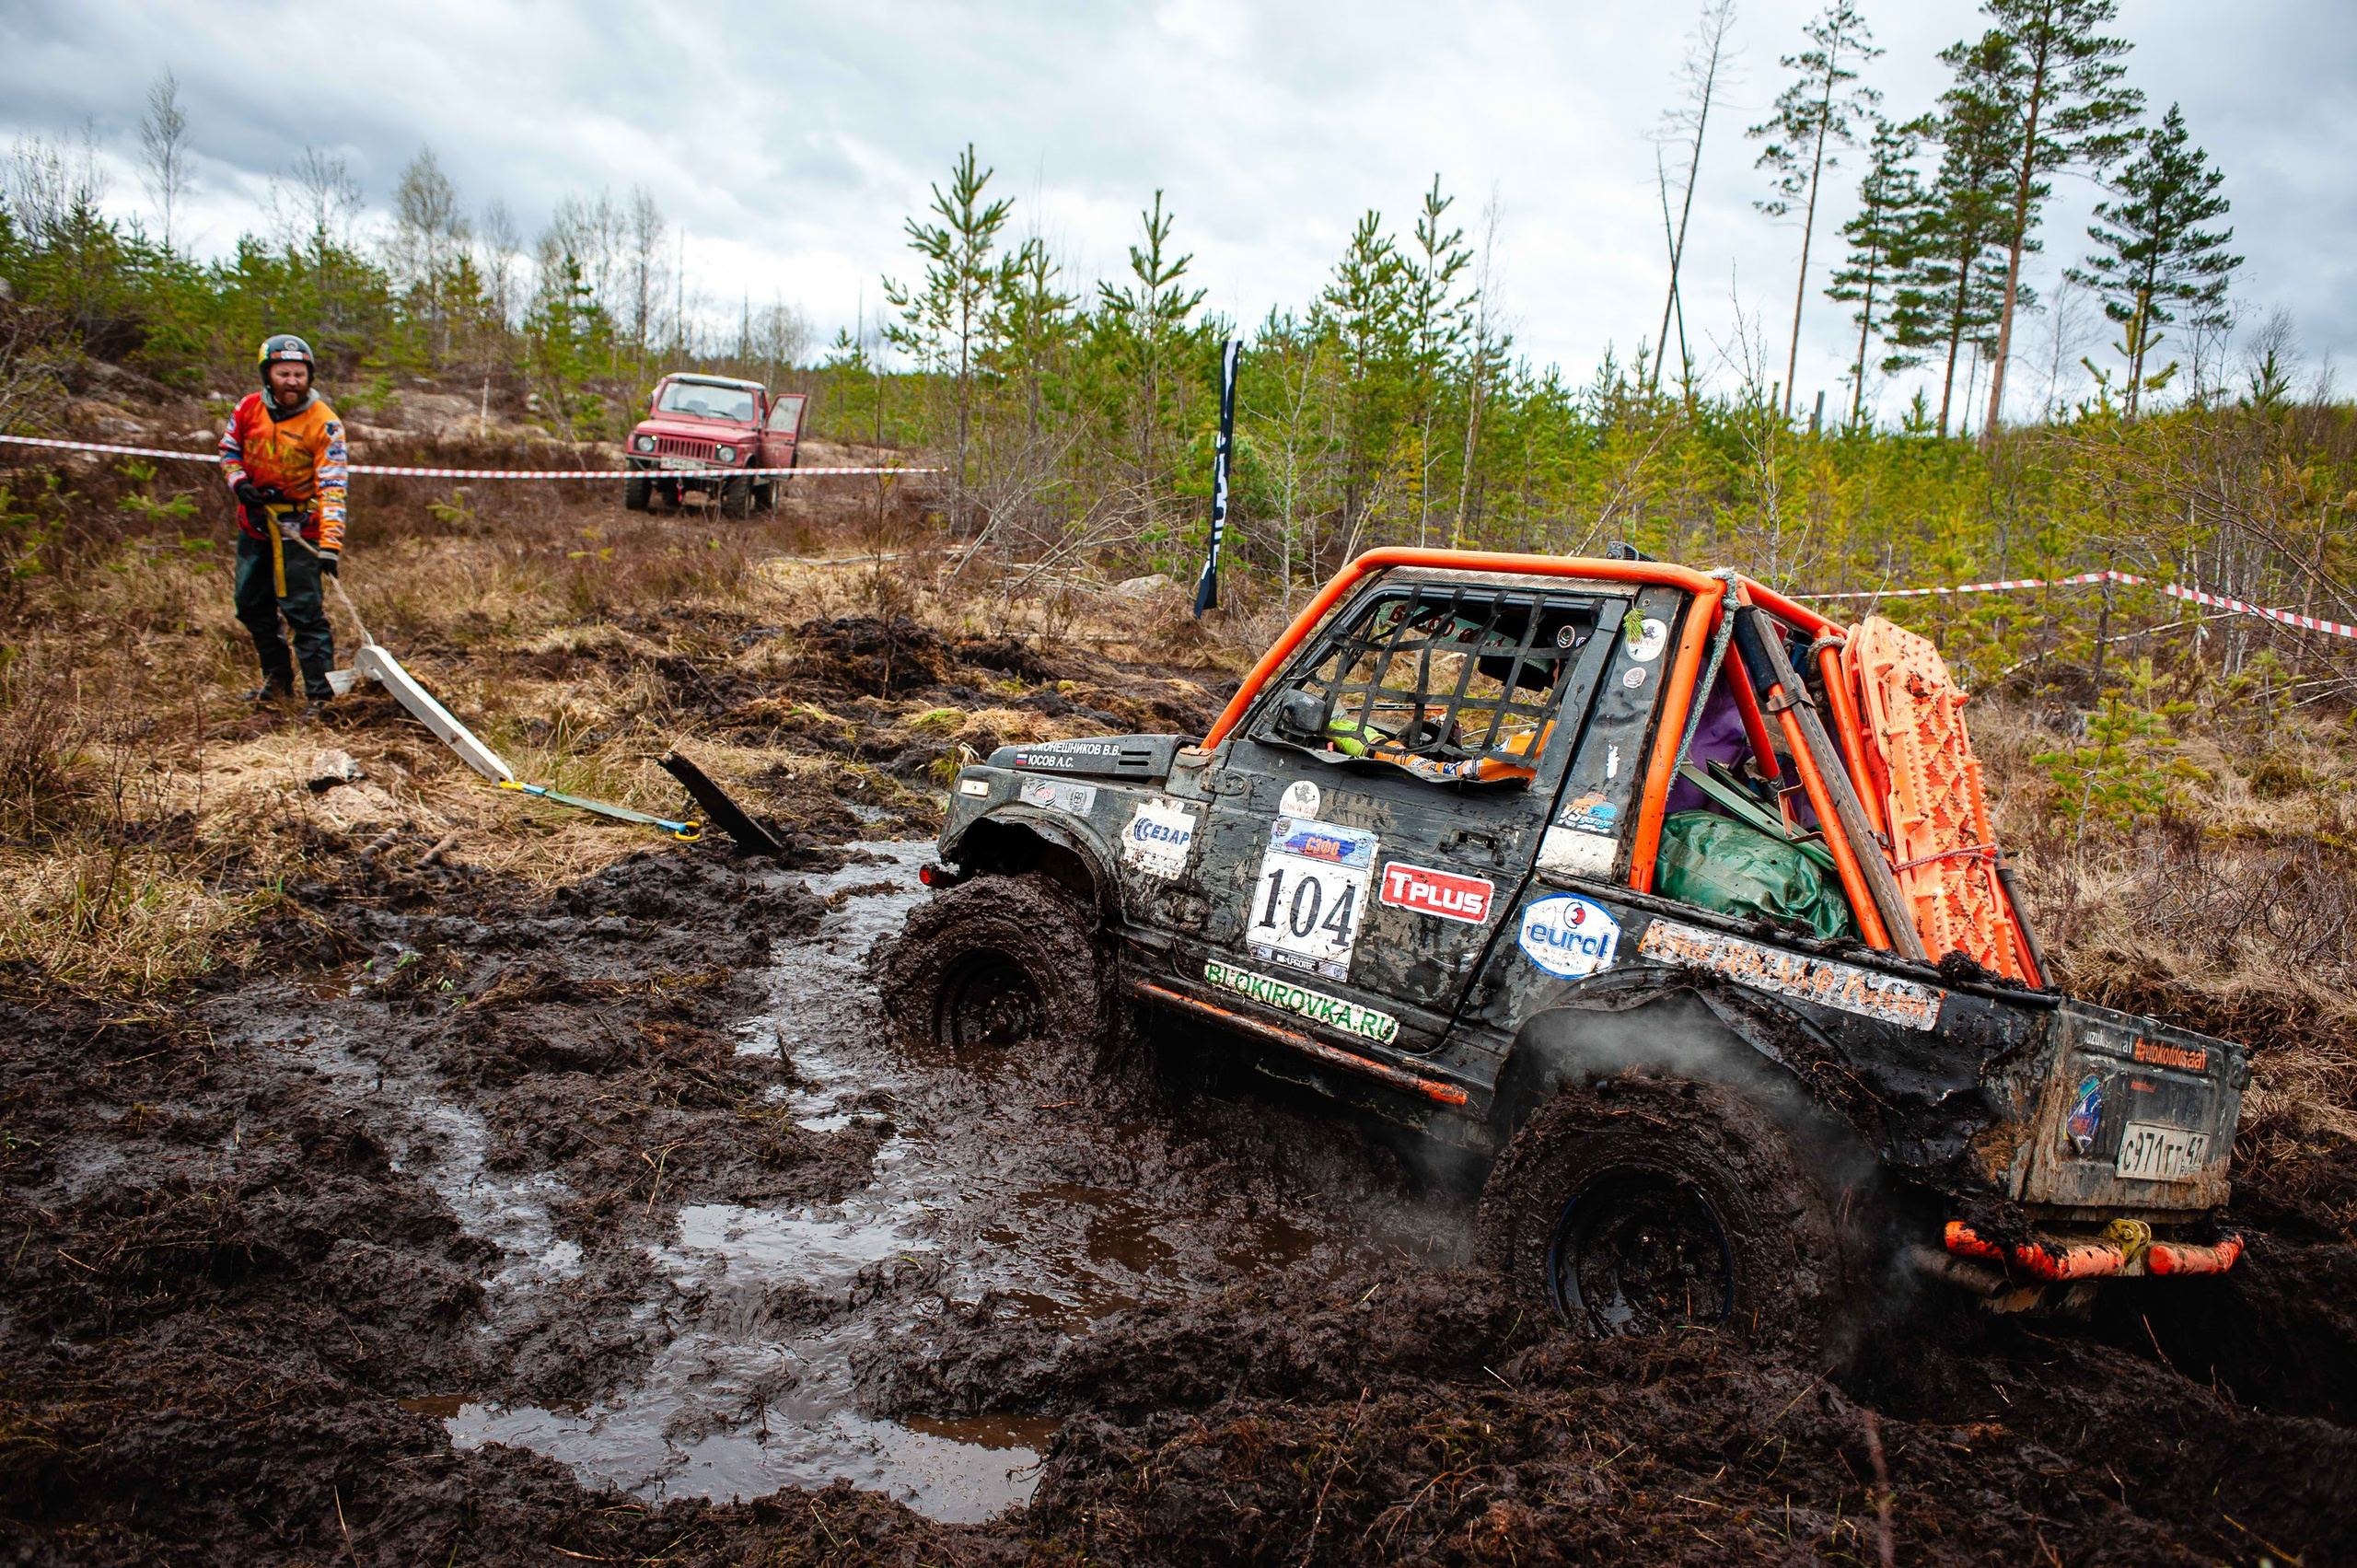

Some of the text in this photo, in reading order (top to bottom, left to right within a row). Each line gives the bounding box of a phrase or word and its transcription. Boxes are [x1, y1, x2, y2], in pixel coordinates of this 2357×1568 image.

[1028, 755, 1074, 768] ЮСОВ А.С.
[1102, 743, 1120, 756] В.В.
[1142, 821, 1190, 845] СЕЗАР
[1259, 868, 1356, 947] 104
[1528, 922, 1611, 960] eurol
[1206, 963, 1396, 1040] BLOKIROVKA.RU
